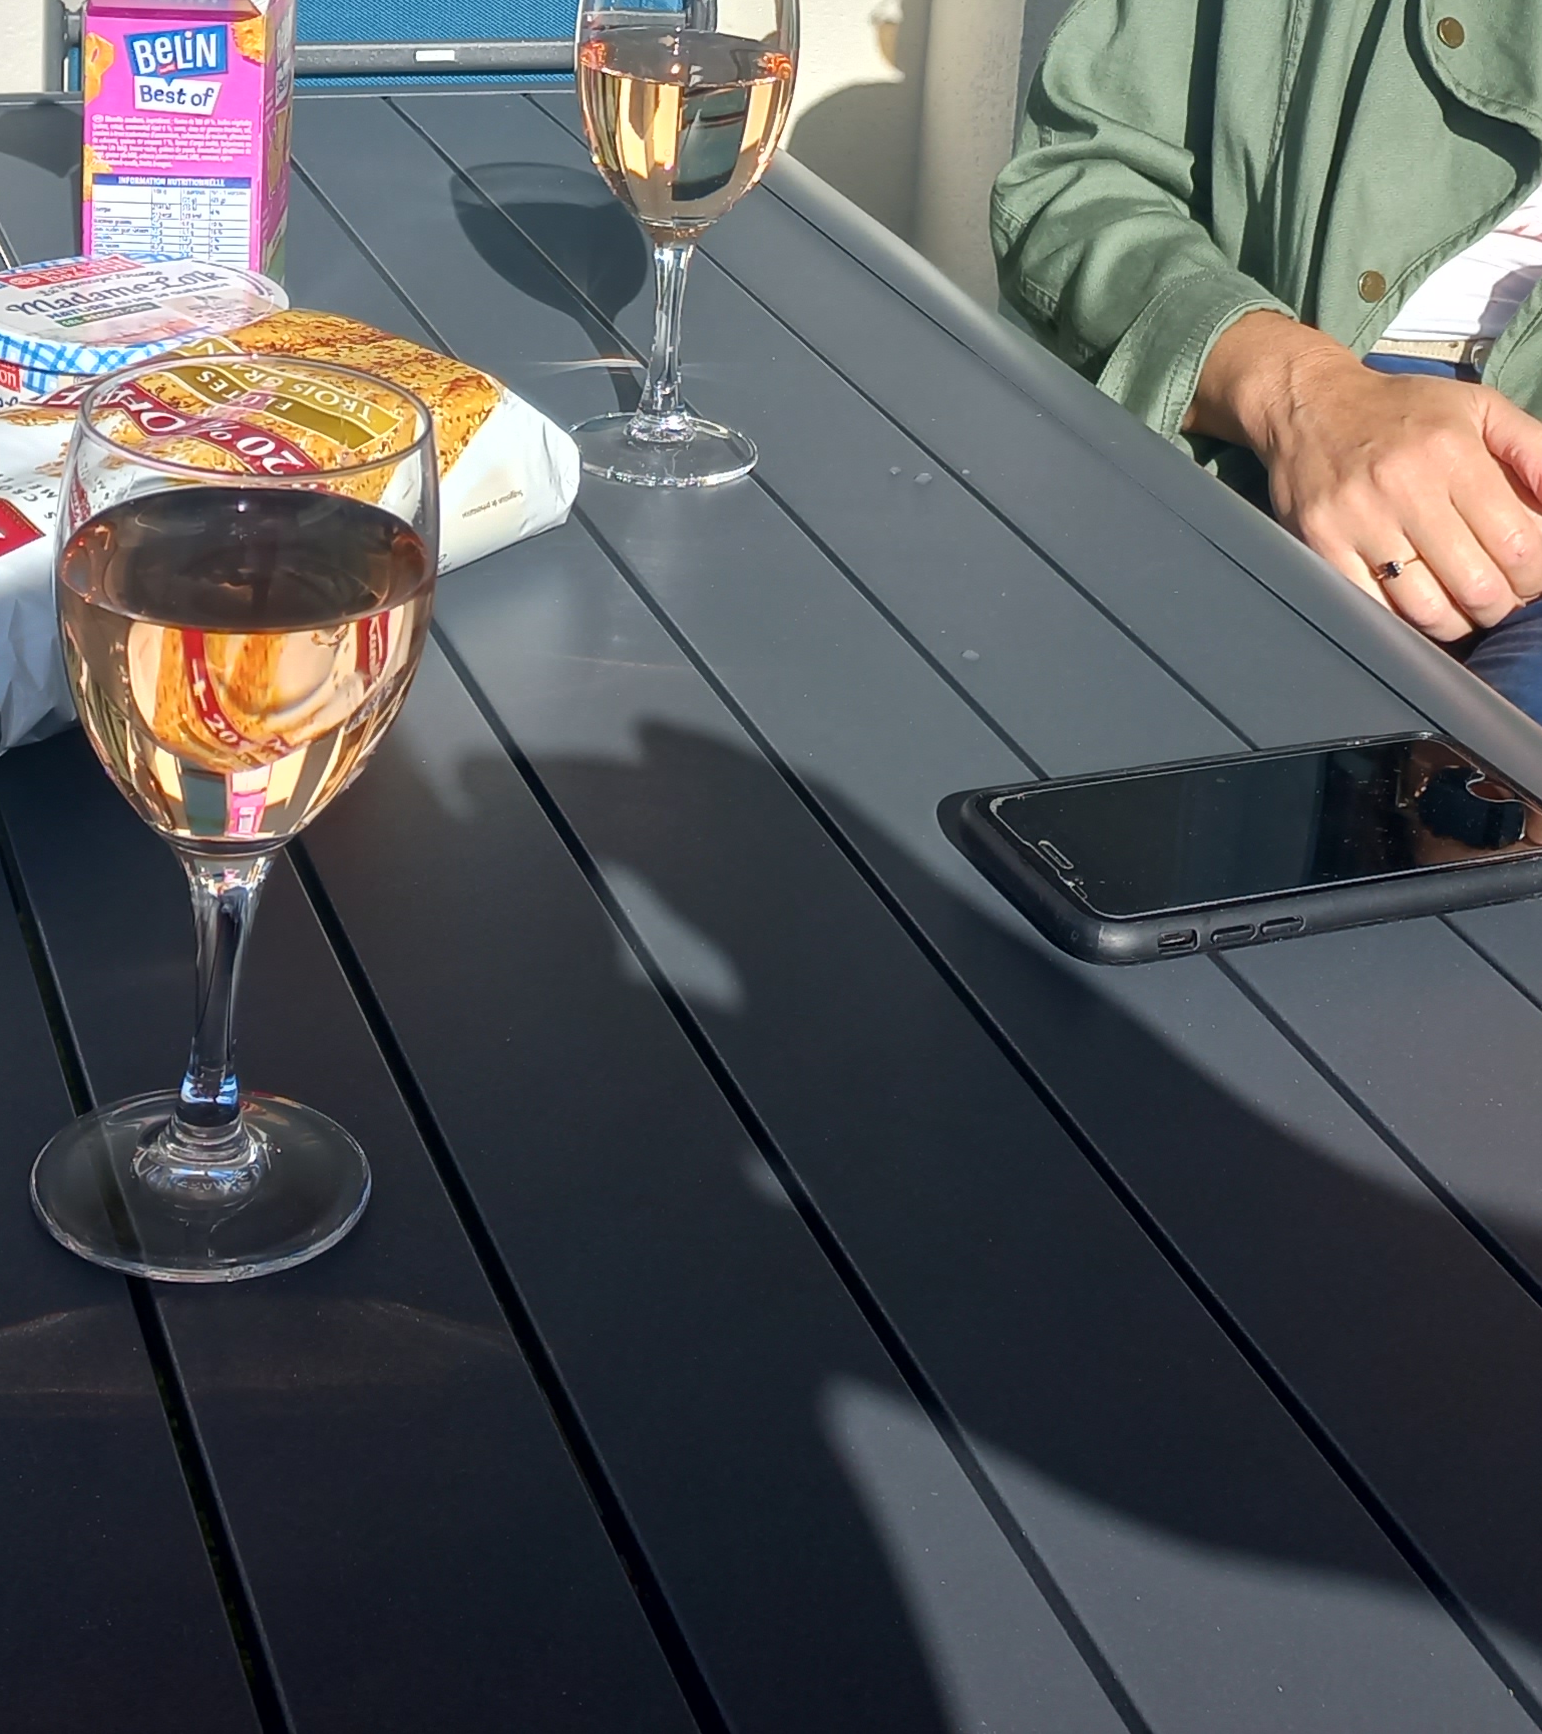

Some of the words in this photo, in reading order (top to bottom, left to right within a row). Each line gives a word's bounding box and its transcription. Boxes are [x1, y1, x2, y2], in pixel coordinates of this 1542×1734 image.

[139, 85, 186, 105] Best
[191, 87, 215, 107] of
[117, 175, 166, 187] INFORMATION
[6, 283, 157, 316] Madame
[45, 302, 114, 319] NATURE
[291, 380, 376, 426] TROIS
